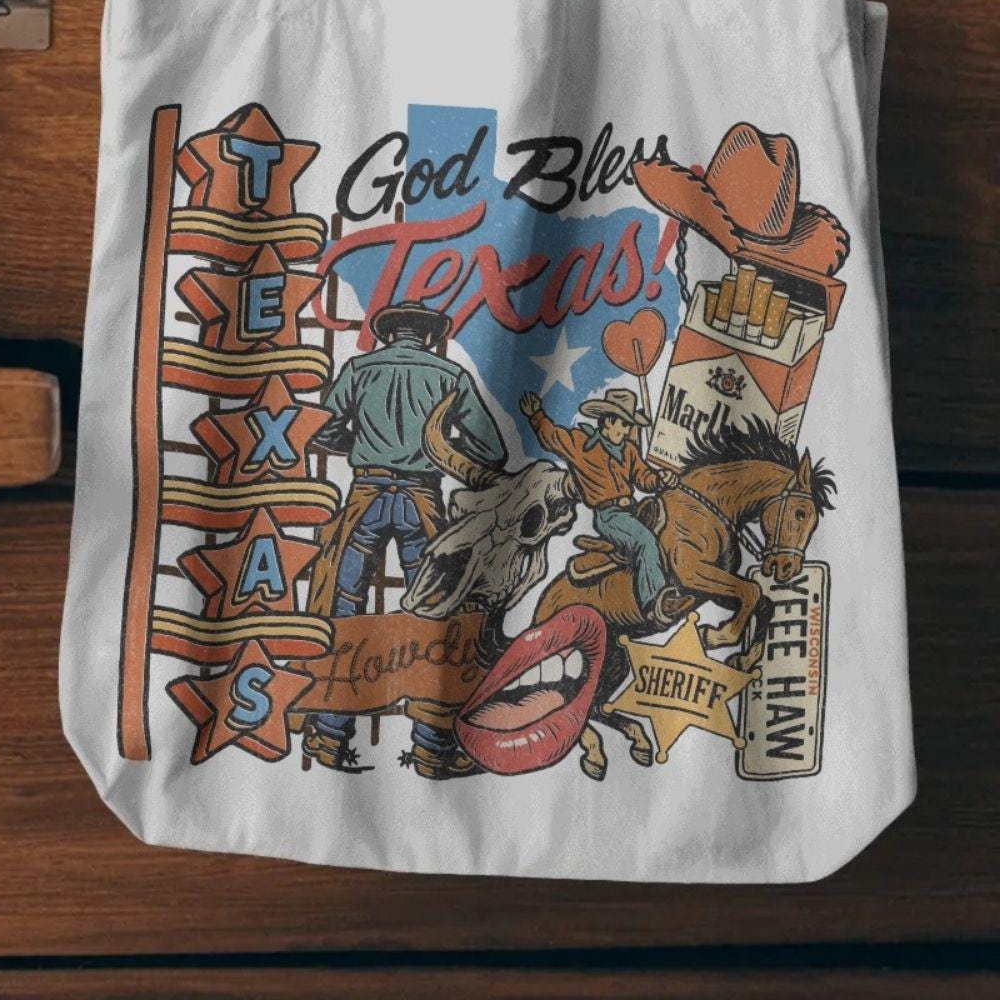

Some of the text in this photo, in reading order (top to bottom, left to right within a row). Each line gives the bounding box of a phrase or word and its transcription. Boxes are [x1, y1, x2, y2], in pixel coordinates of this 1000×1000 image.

[336, 125, 489, 222] God
[310, 200, 680, 351] Texas!
[635, 664, 728, 710] SHERIFF
[807, 606, 822, 697] WISCONSIN
[765, 675, 807, 761] HAW
